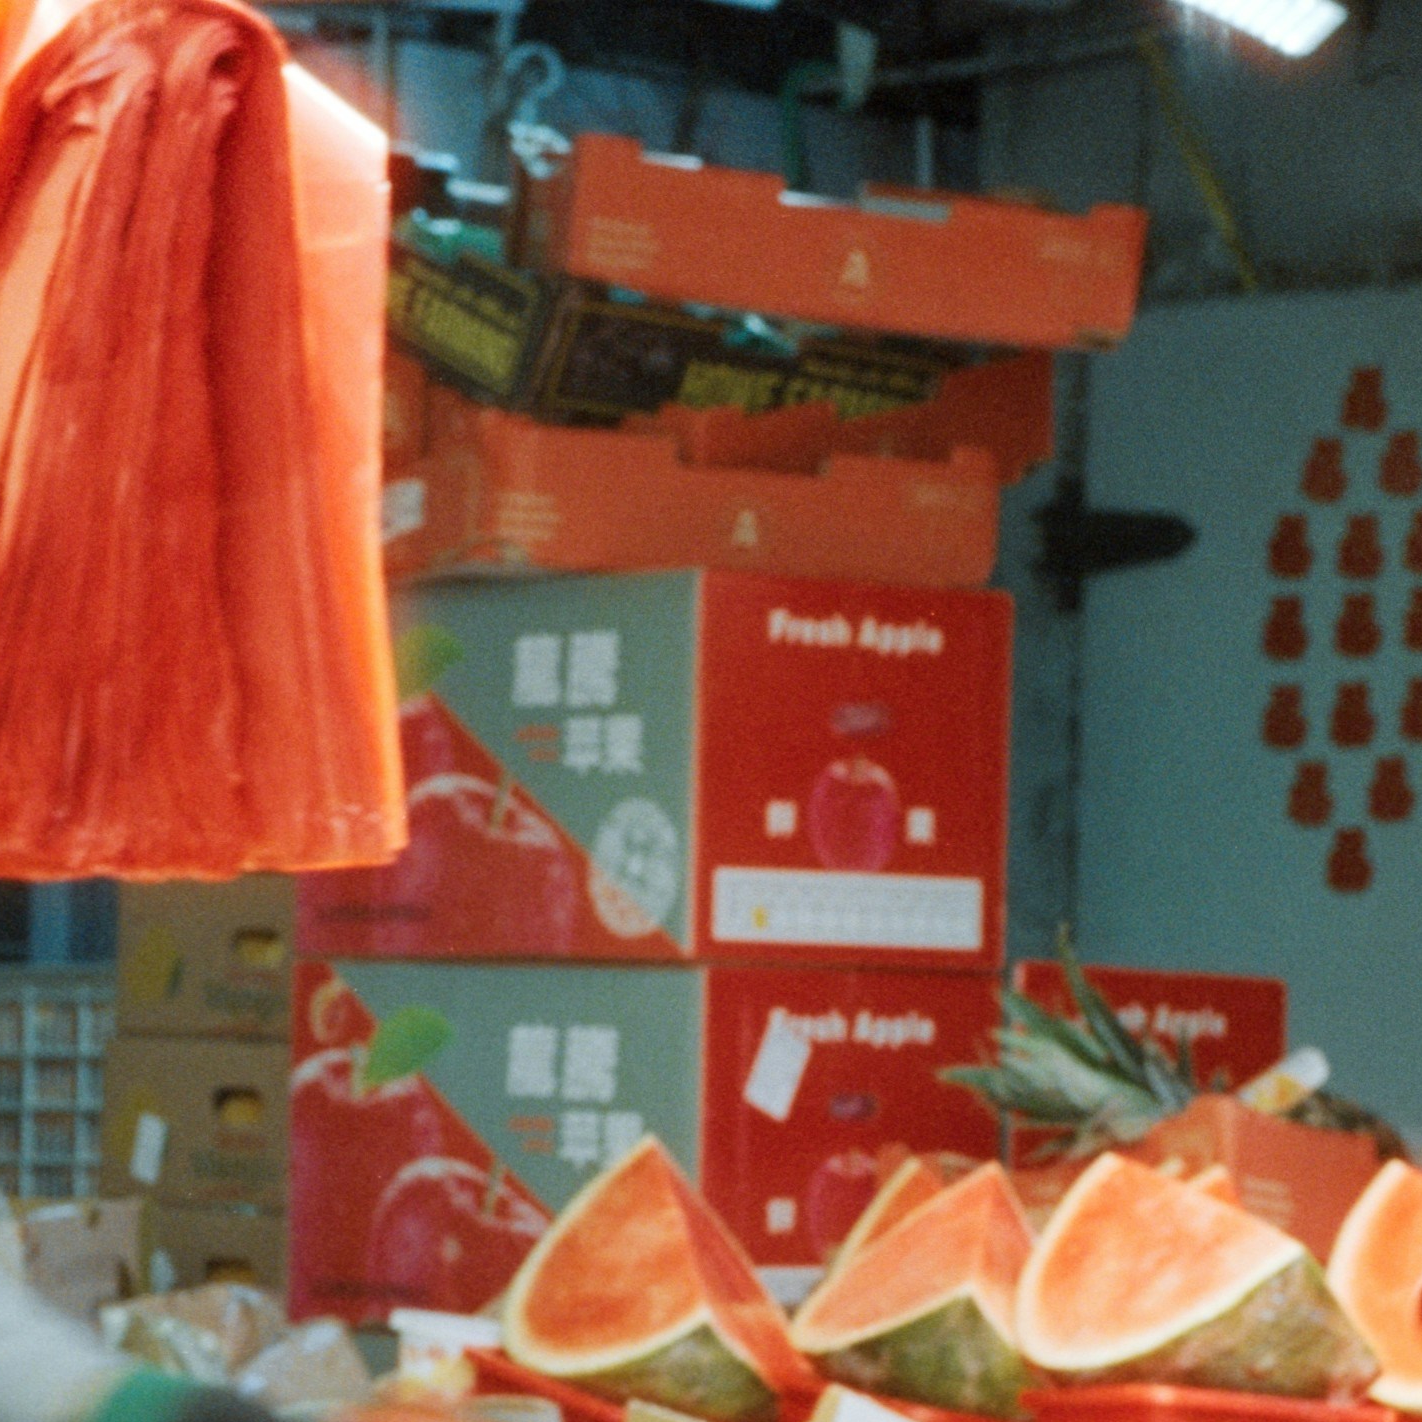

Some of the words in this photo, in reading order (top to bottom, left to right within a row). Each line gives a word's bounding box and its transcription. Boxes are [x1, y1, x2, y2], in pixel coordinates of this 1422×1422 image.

[768, 607, 852, 647] Fresh
[858, 614, 946, 658] Apple
[852, 1010, 937, 1049] Apple
